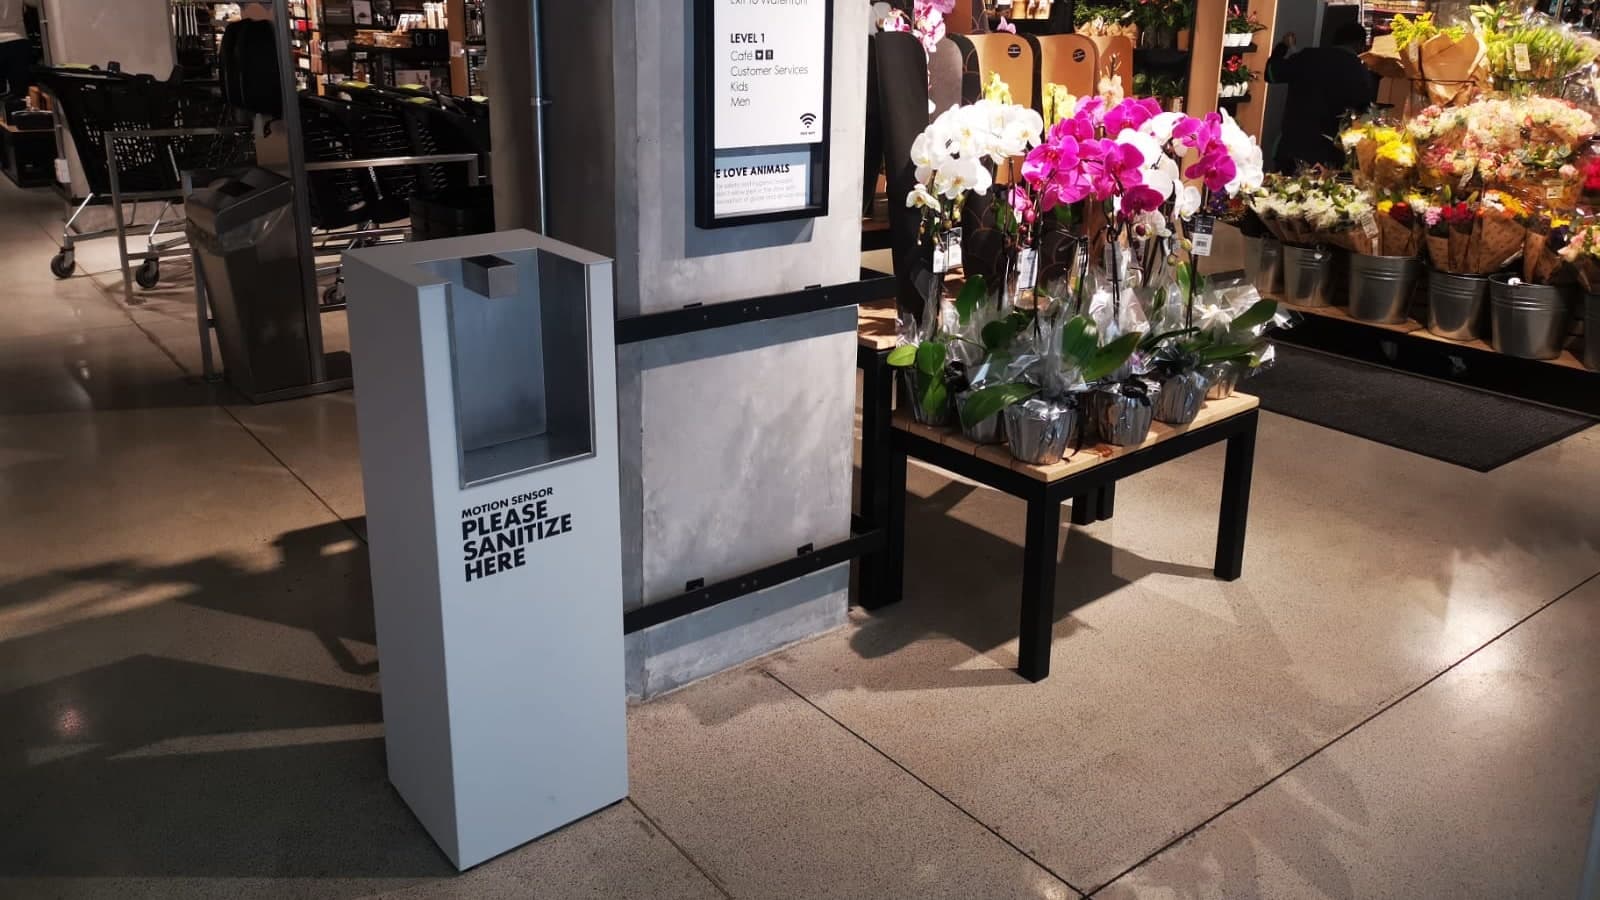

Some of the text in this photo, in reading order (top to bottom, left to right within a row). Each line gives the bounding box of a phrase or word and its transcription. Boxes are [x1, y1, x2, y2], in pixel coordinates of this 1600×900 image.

[730, 33, 765, 43] LEVEL 1
[730, 65, 809, 76] Customer Services
[730, 82, 749, 92] Kids
[730, 97, 751, 107] Men
[715, 163, 790, 179] E LOVE ANIMALS
[462, 487, 554, 519] MOTION SENSOR
[462, 500, 548, 541] PLEASE
[464, 513, 573, 561] SANITIZE
[465, 547, 526, 582] HERE
